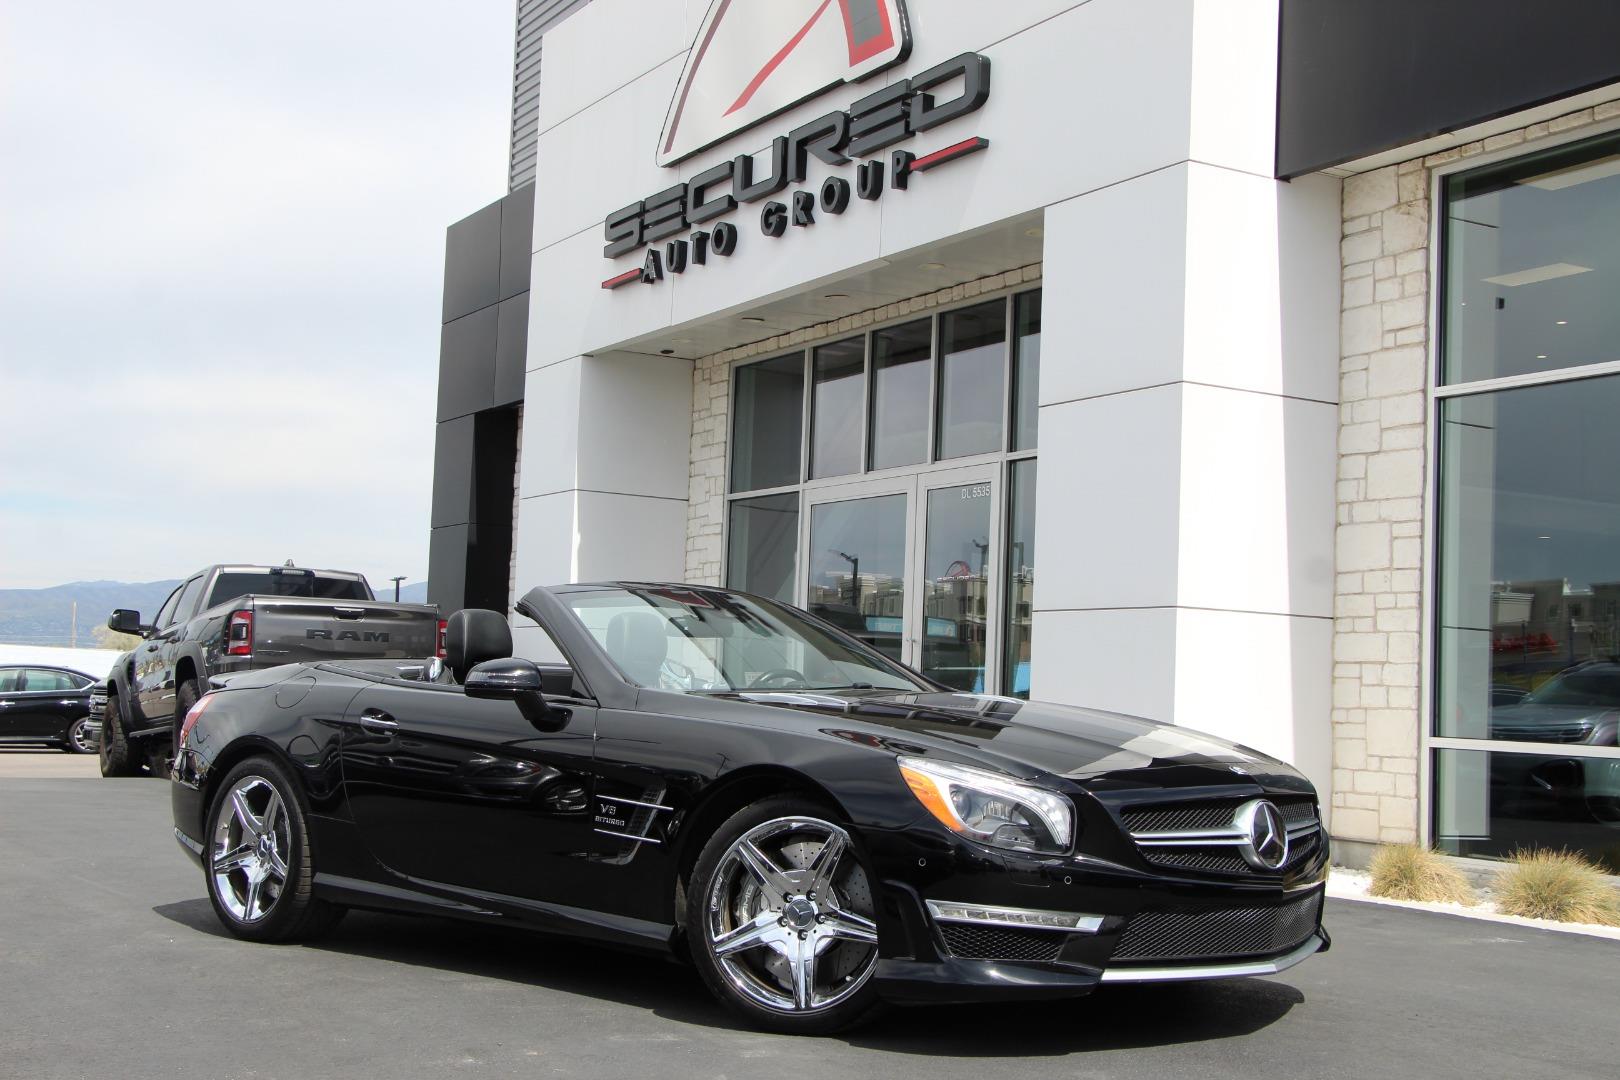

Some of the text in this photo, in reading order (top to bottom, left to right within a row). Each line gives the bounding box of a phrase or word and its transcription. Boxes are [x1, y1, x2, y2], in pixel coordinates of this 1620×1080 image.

[604, 51, 991, 259] SECURED
[640, 149, 916, 285] AUTO GROUP
[305, 628, 390, 643] RAM
